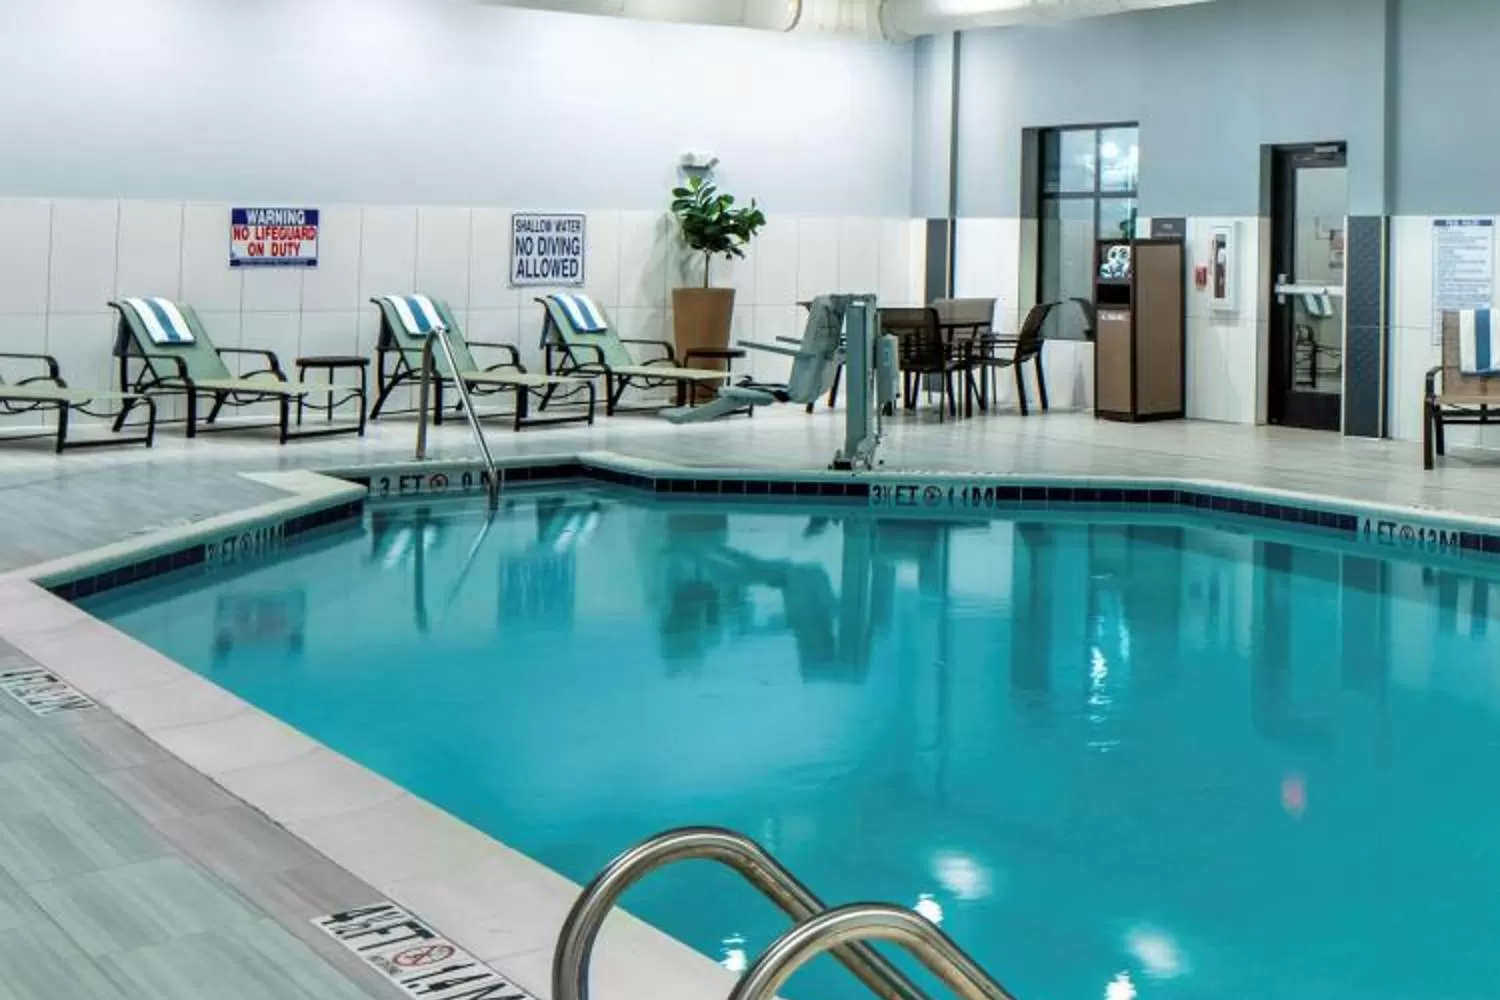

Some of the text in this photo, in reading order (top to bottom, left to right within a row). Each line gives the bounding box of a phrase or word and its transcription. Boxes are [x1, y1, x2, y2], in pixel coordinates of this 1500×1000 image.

[246, 209, 305, 225] WARNING
[233, 226, 316, 240] NO LIFEGUARD
[516, 219, 580, 232] SHALLOW WATER
[248, 242, 301, 256] ON DUTY
[515, 236, 580, 256] NO DIVING
[515, 258, 578, 278] ALLOWED
[341, 921, 435, 952] FT
